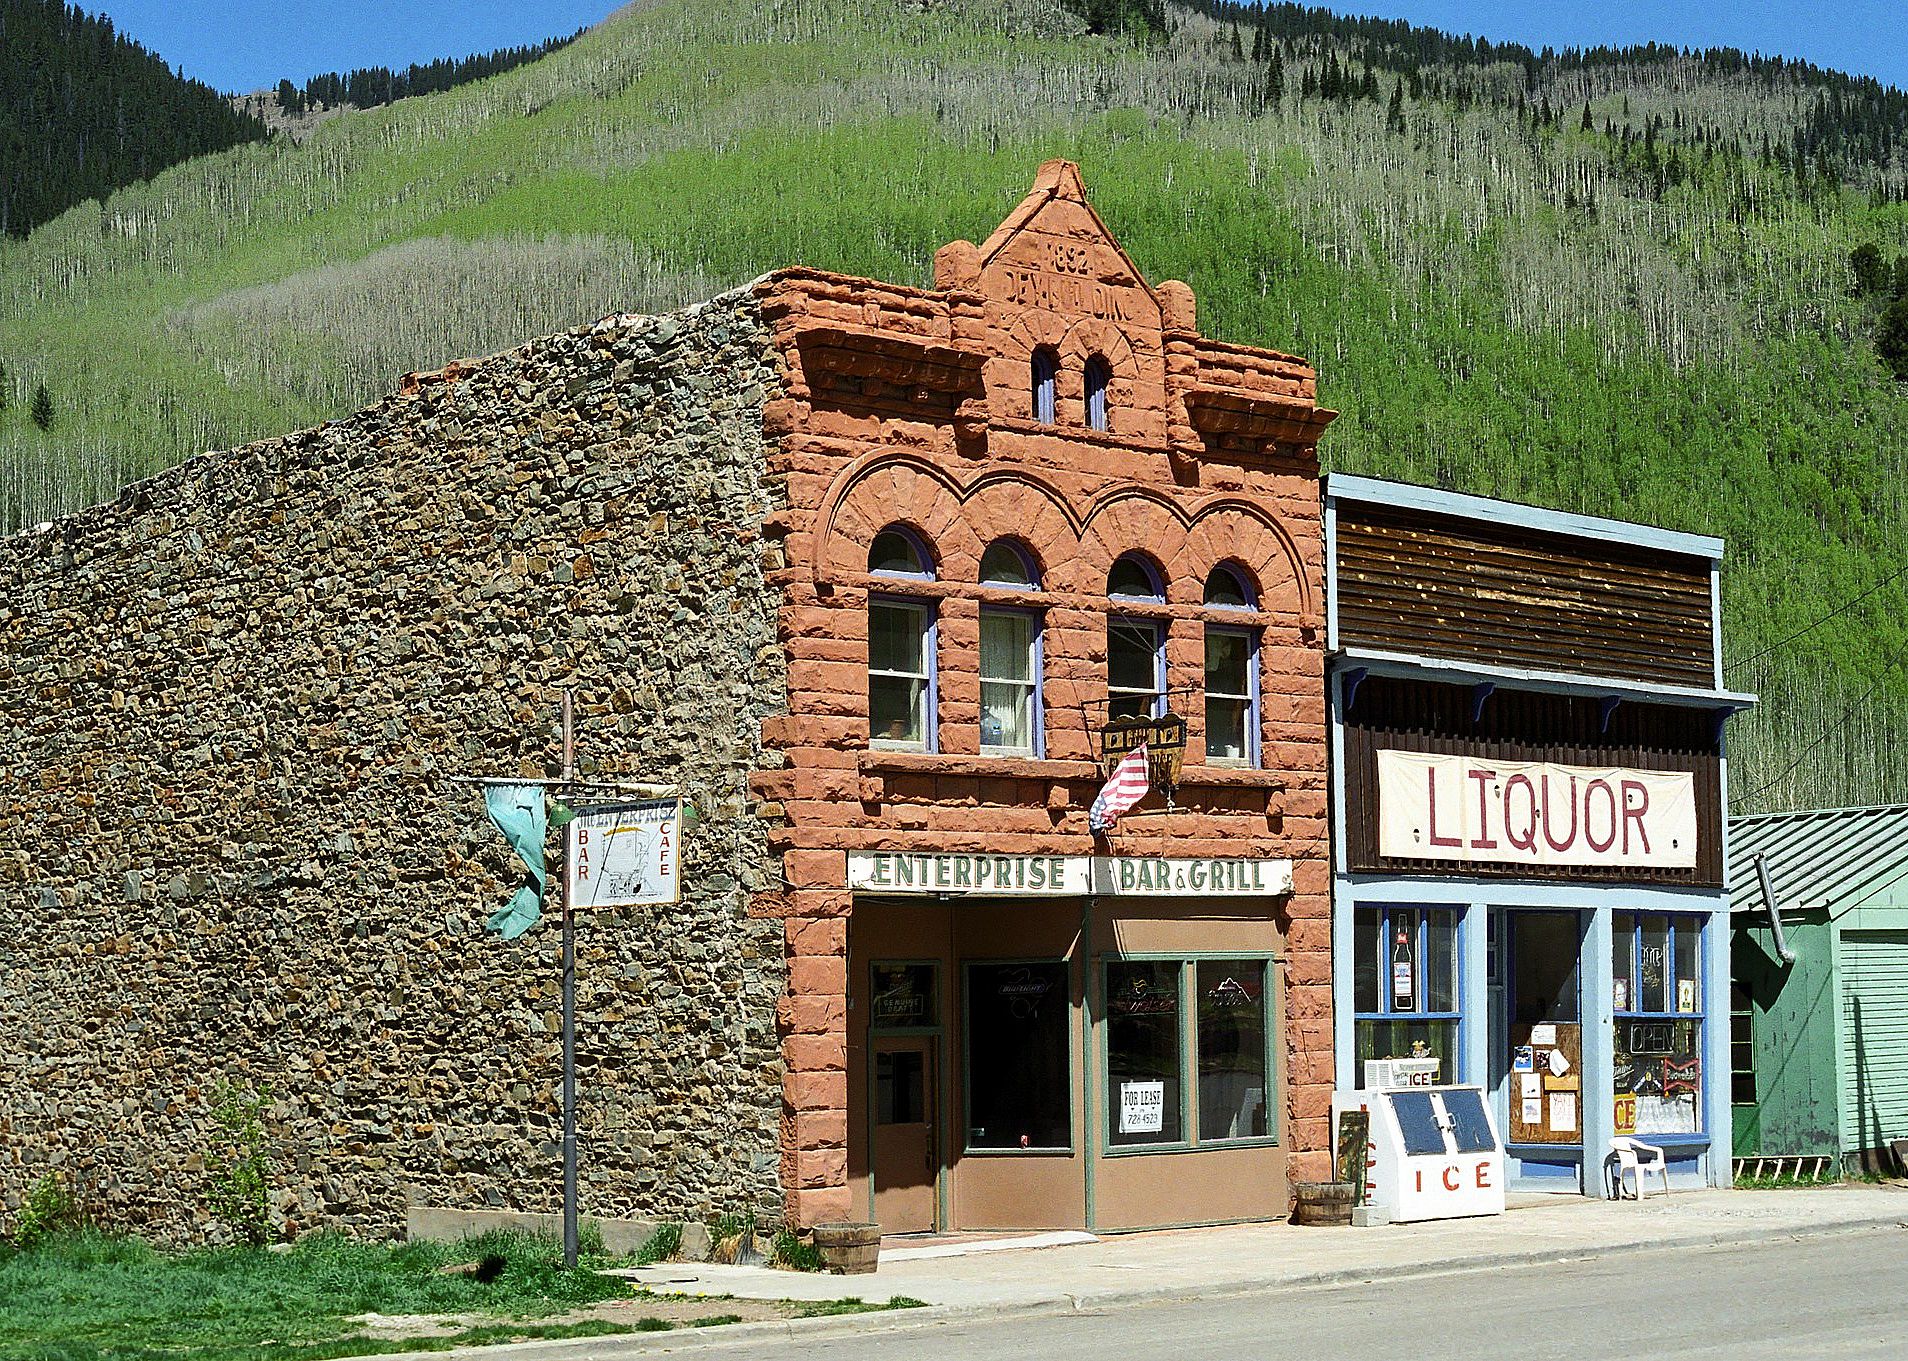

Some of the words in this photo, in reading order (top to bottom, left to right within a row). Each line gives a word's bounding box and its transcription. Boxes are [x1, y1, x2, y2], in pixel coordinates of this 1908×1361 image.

[1428, 766, 1651, 856] LIQUOR
[578, 829, 589, 880] BAR
[659, 822, 671, 876] CAFE
[873, 853, 1065, 889] ENTERPRISE
[1120, 859, 1171, 891] BAR
[1189, 860, 1265, 891] GRILL
[1632, 1026, 1673, 1050] OPEN
[1409, 1072, 1430, 1086] ICE
[1124, 1091, 1138, 1106] FOR
[1140, 1090, 1161, 1106] LEASE
[1415, 1161, 1491, 1193] ICE
